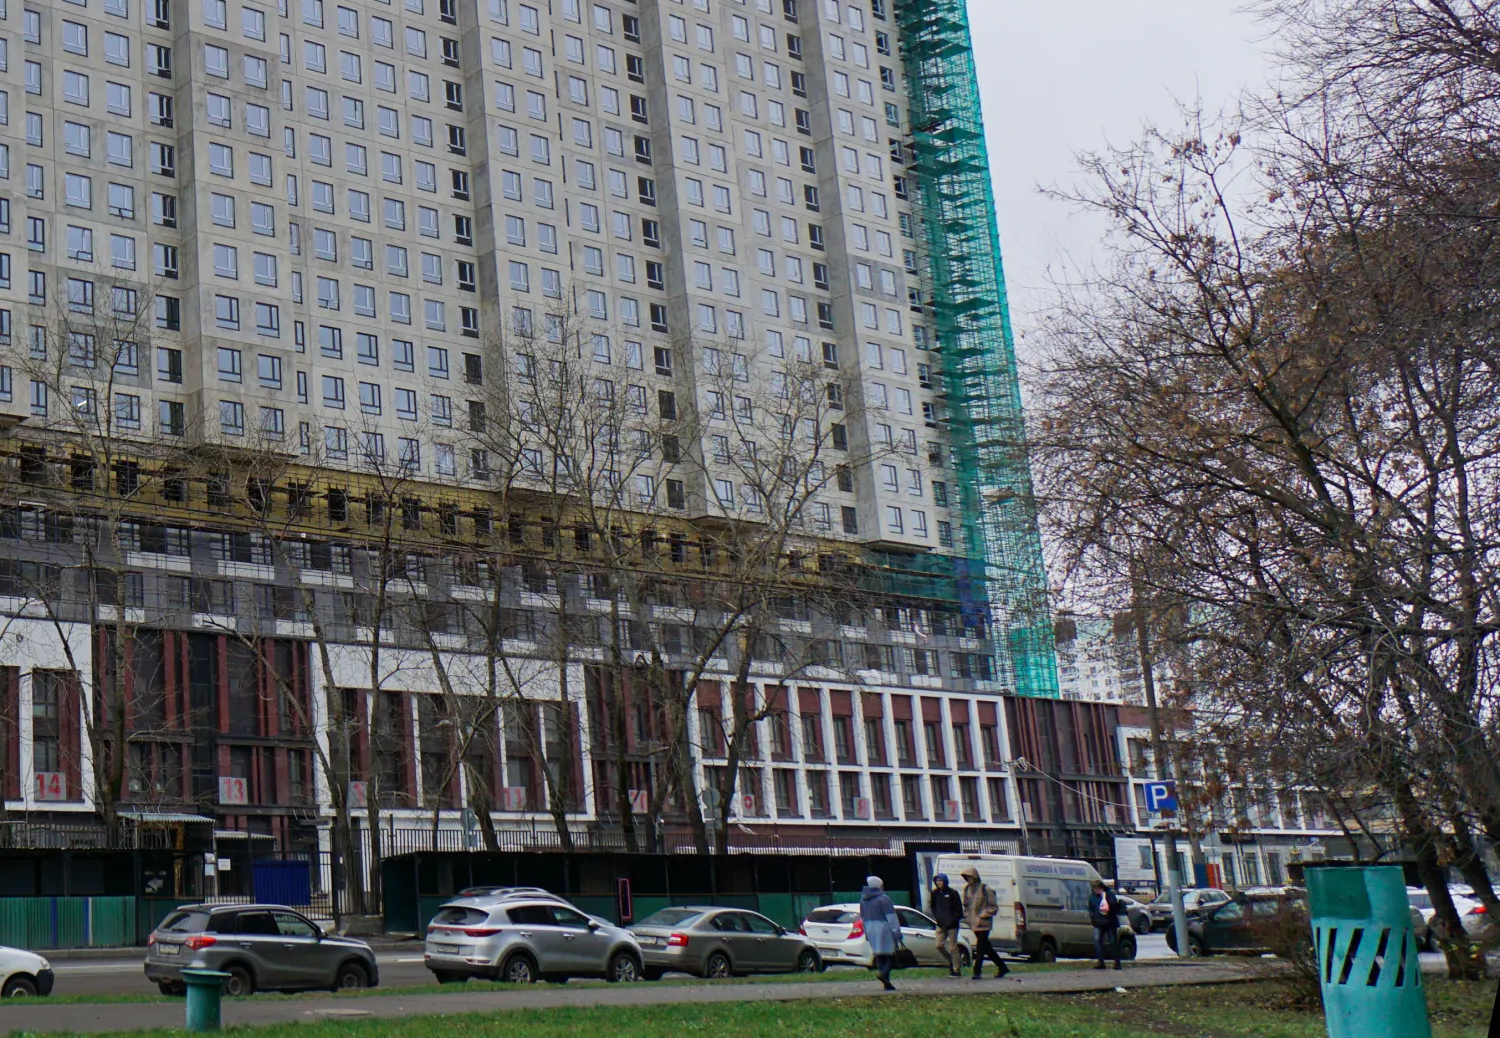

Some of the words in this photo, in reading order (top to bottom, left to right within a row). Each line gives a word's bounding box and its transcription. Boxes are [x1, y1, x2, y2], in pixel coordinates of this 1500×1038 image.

[36, 773, 62, 799] 14
[224, 778, 244, 802] 13
[1151, 785, 1168, 810] P
